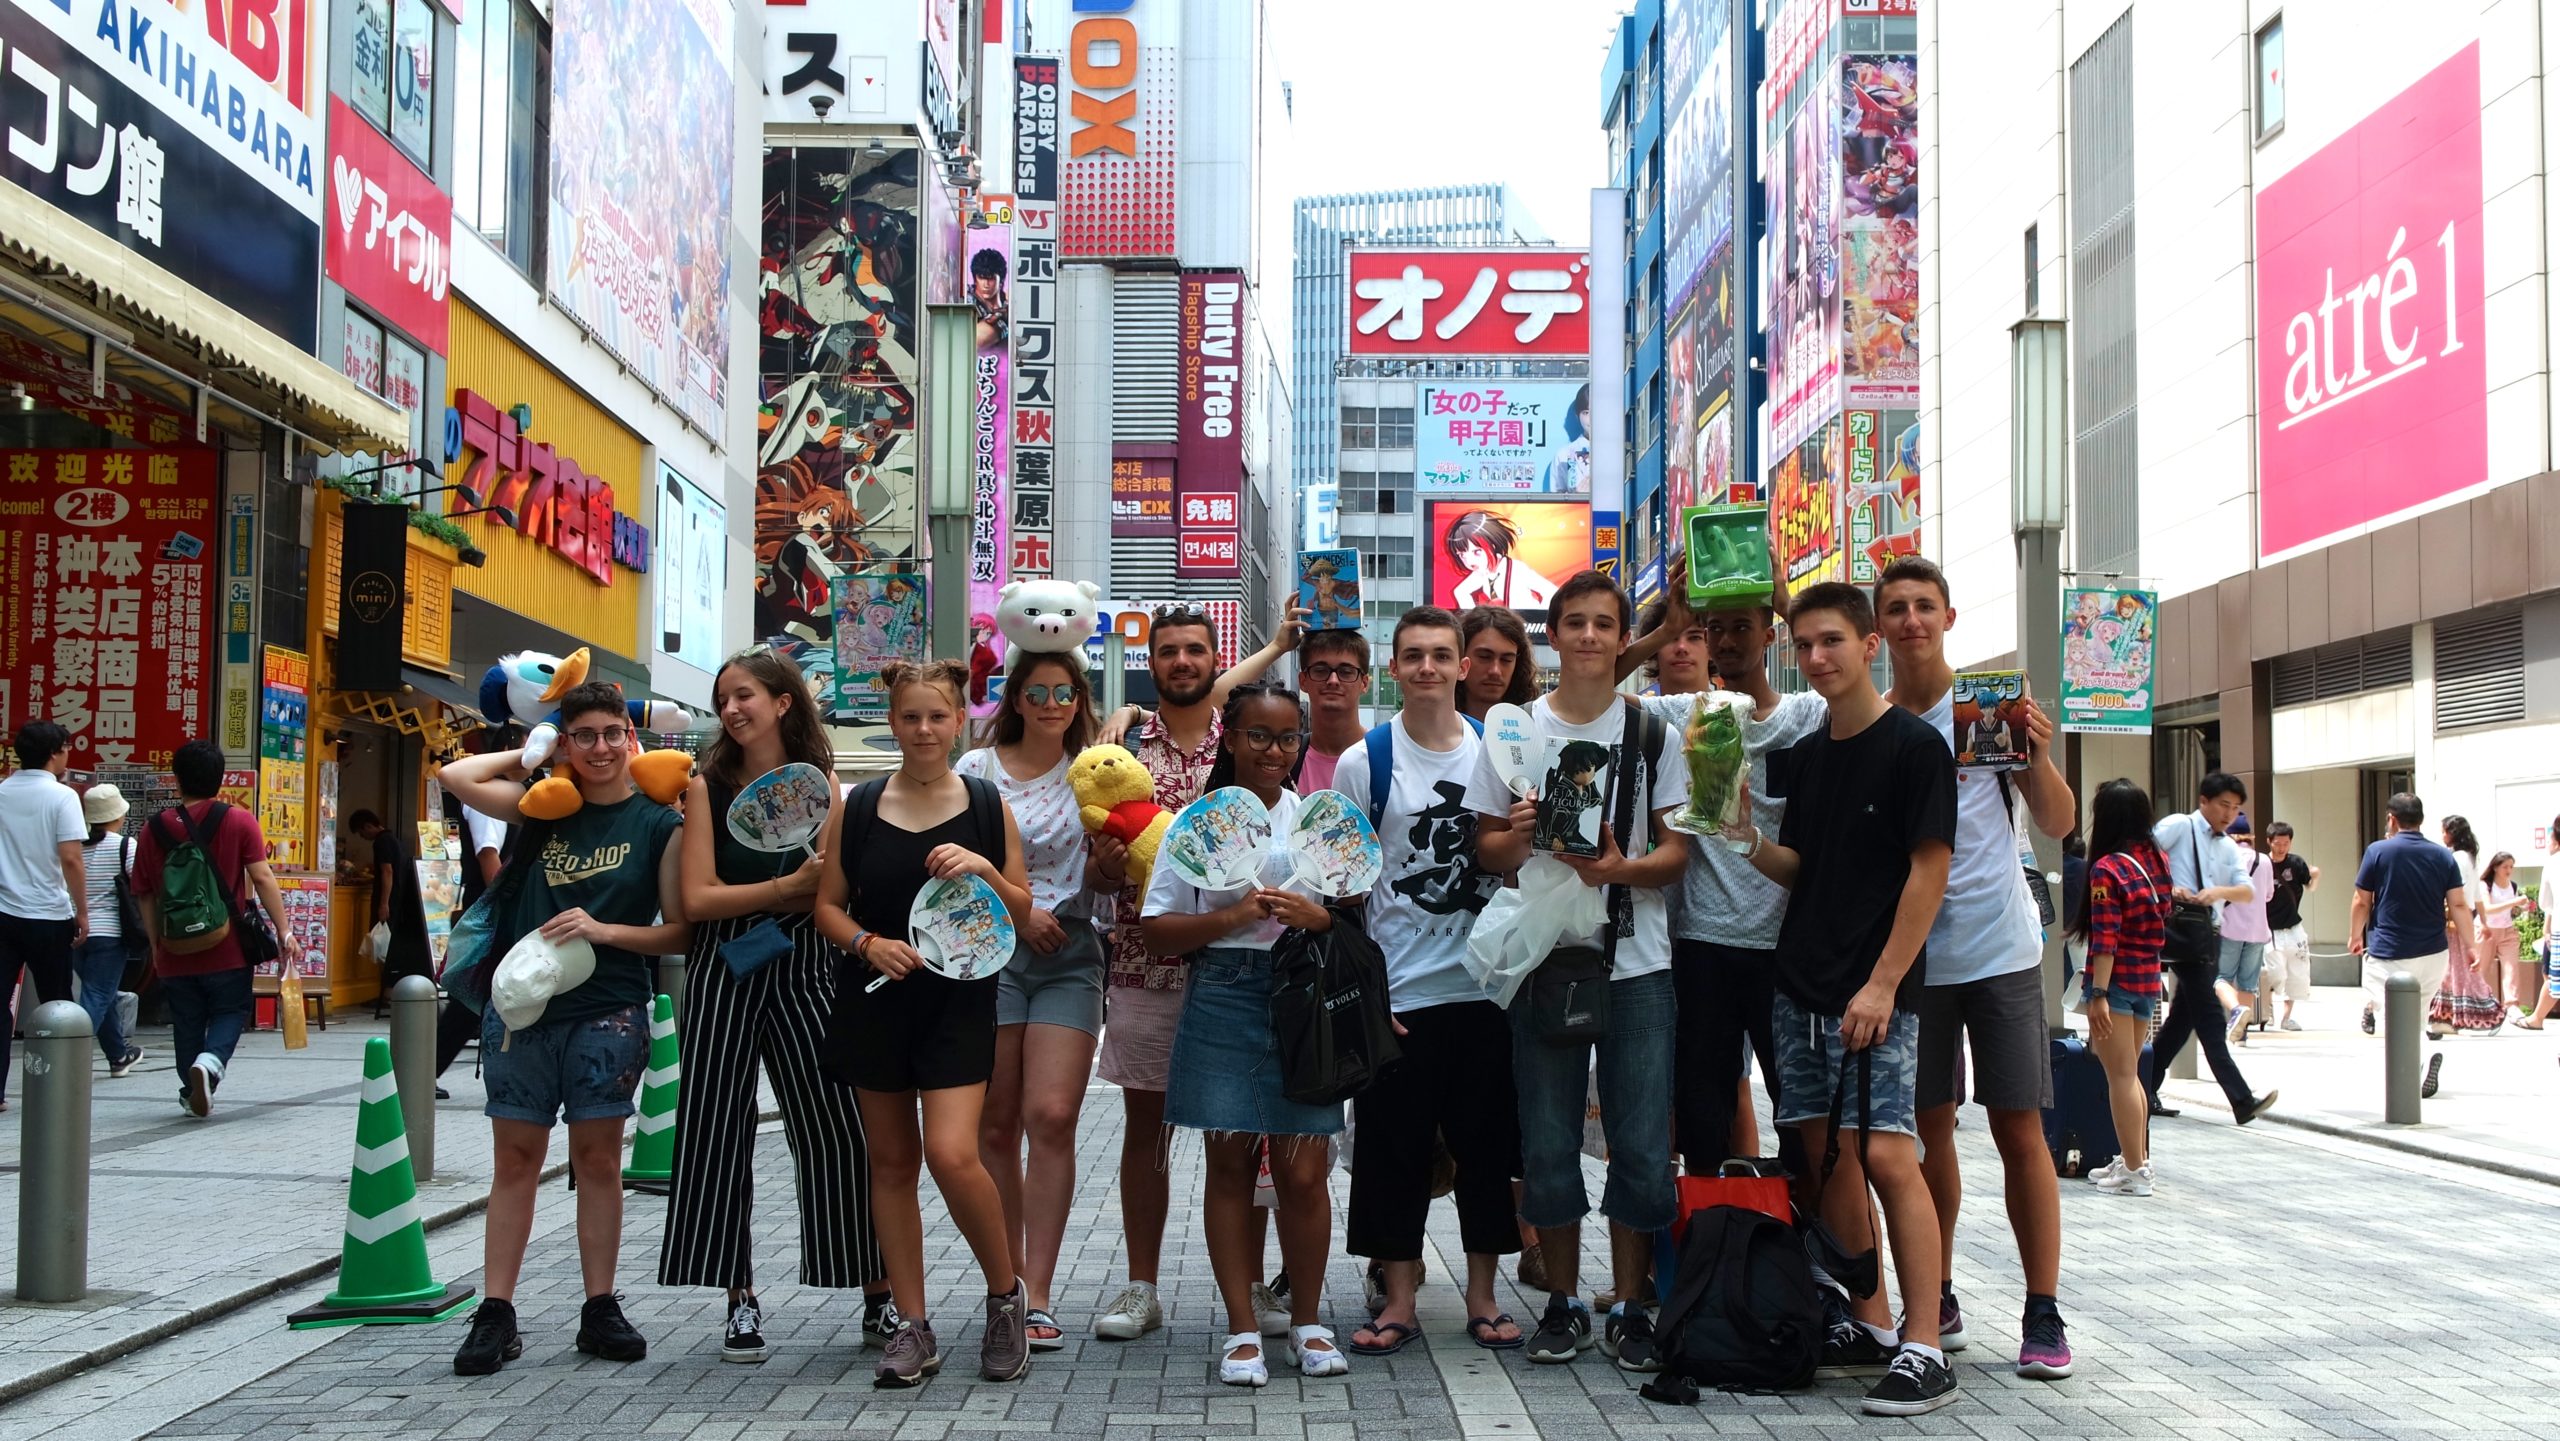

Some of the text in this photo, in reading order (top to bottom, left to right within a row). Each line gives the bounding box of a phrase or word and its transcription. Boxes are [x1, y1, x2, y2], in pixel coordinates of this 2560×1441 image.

[355, 26, 388, 94] 金利
[96, 0, 314, 197] AKIHABARA
[1018, 65, 1037, 194] PARADISE
[1038, 65, 1056, 152] HOBBY
[364, 176, 447, 301] アイフル
[1184, 281, 1201, 401] Flagship Store
[2285, 220, 2464, 415] atré 1
[1202, 282, 1240, 438] Duty Free
[1013, 243, 1053, 580] ボークス秋葉原ホ
[8, 453, 179, 485] 欢迎光临
[973, 355, 998, 582] ぱちんこCR真・北斗無双
[1112, 460, 1143, 476] 本店
[1112, 477, 1172, 492] 総合家電
[1424, 469, 1472, 485] マウンド
[1186, 499, 1233, 522] 免税
[1597, 529, 1617, 547] 薬
[1184, 541, 1234, 559] 면세점
[356, 590, 388, 604] mini
[229, 688, 247, 749] 平板电脑
